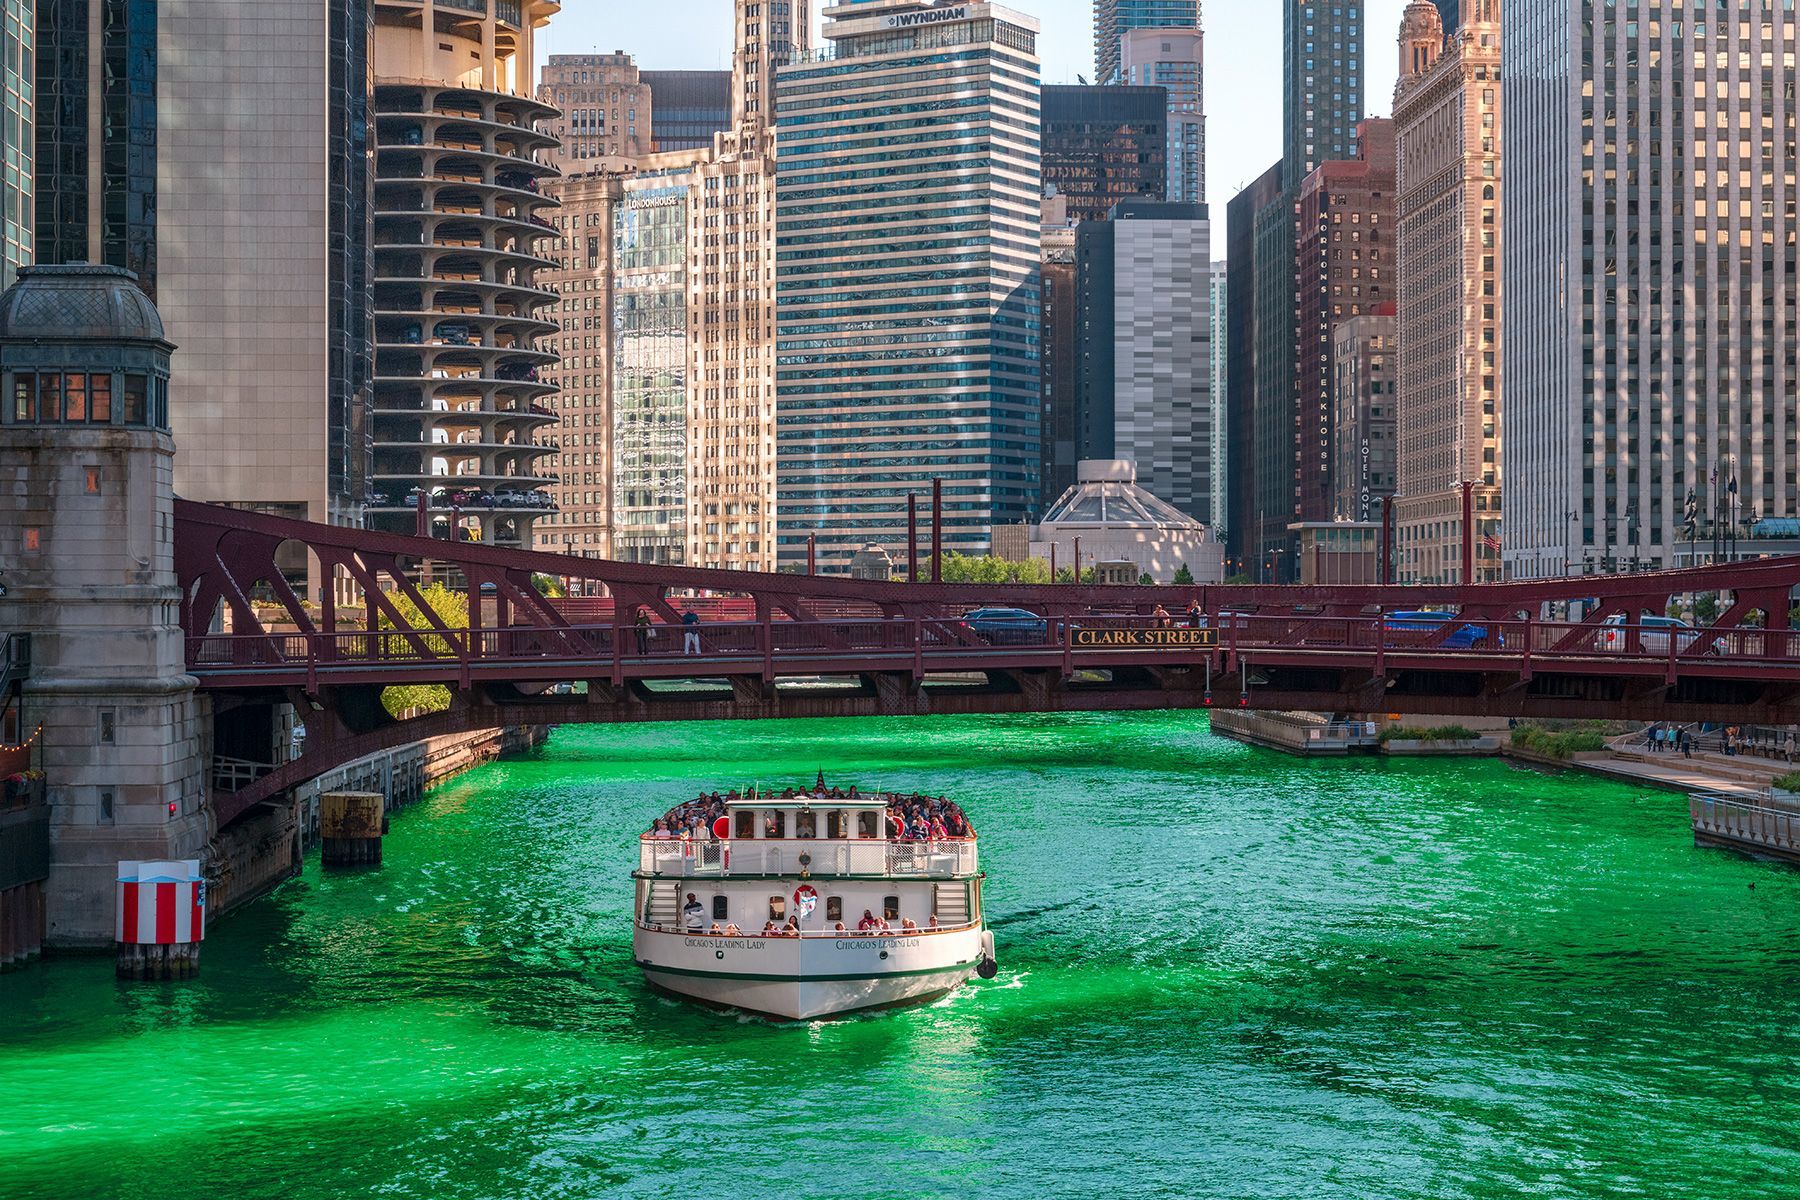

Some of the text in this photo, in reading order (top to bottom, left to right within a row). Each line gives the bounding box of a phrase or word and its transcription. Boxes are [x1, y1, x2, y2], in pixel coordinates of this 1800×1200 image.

[900, 7, 965, 26] WYNDHAM
[1320, 310, 1328, 342] THE
[1320, 353, 1328, 472] STEAKHOUSE
[1361, 438, 1369, 522] HOTEL MONA
[1078, 631, 1211, 644] CLARK STREET
[715, 939, 745, 950] LEADING
[746, 940, 766, 950] LADY
[835, 939, 877, 950] CHICAGO'S
